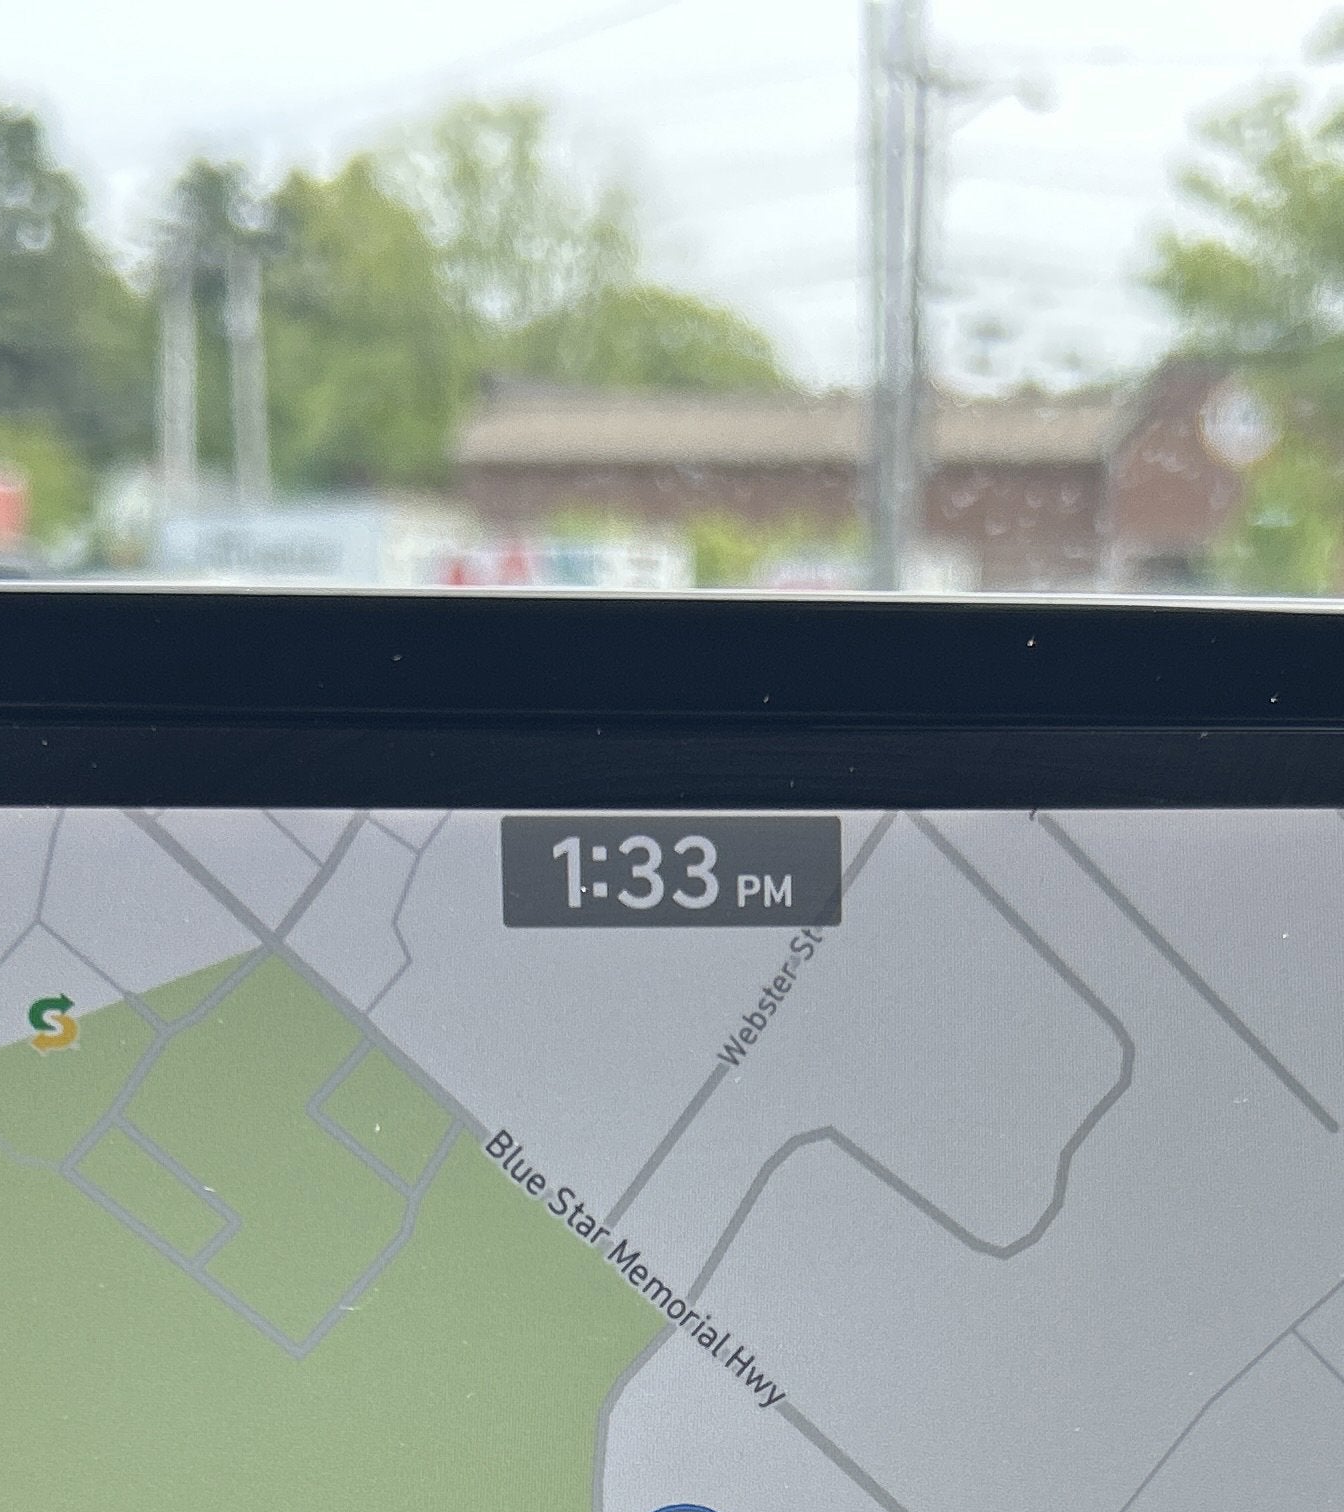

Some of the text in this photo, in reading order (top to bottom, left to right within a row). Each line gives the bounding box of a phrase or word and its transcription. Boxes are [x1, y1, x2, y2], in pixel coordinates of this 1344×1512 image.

[553, 836, 792, 909] 1:33 PM
[717, 926, 823, 1068] Webster St
[484, 1129, 786, 1411] Blue Star Memorial Hwy
